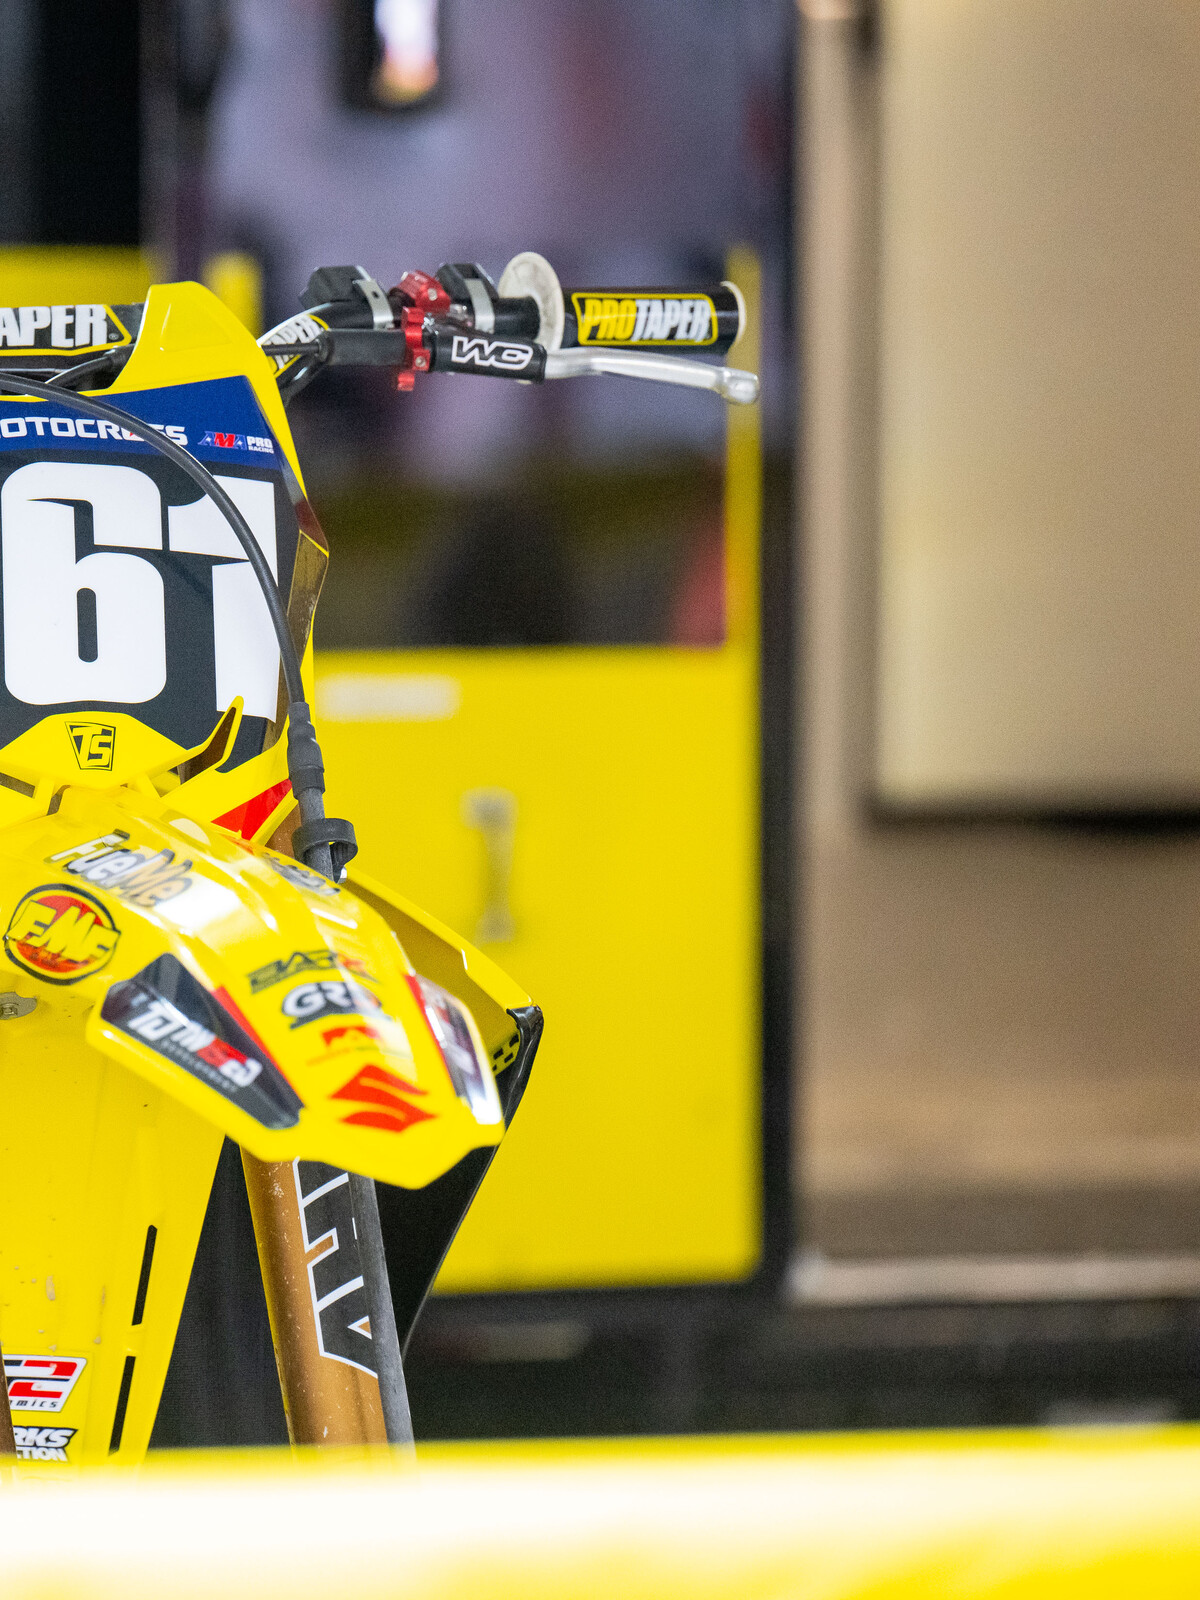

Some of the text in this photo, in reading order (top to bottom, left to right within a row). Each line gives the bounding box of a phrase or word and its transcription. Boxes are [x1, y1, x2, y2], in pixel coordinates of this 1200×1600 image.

[579, 298, 712, 342] PROTAPER
[451, 335, 533, 370] WC
[197, 430, 273, 450] AMA PRO
[12, 1426, 79, 1449] RKS
